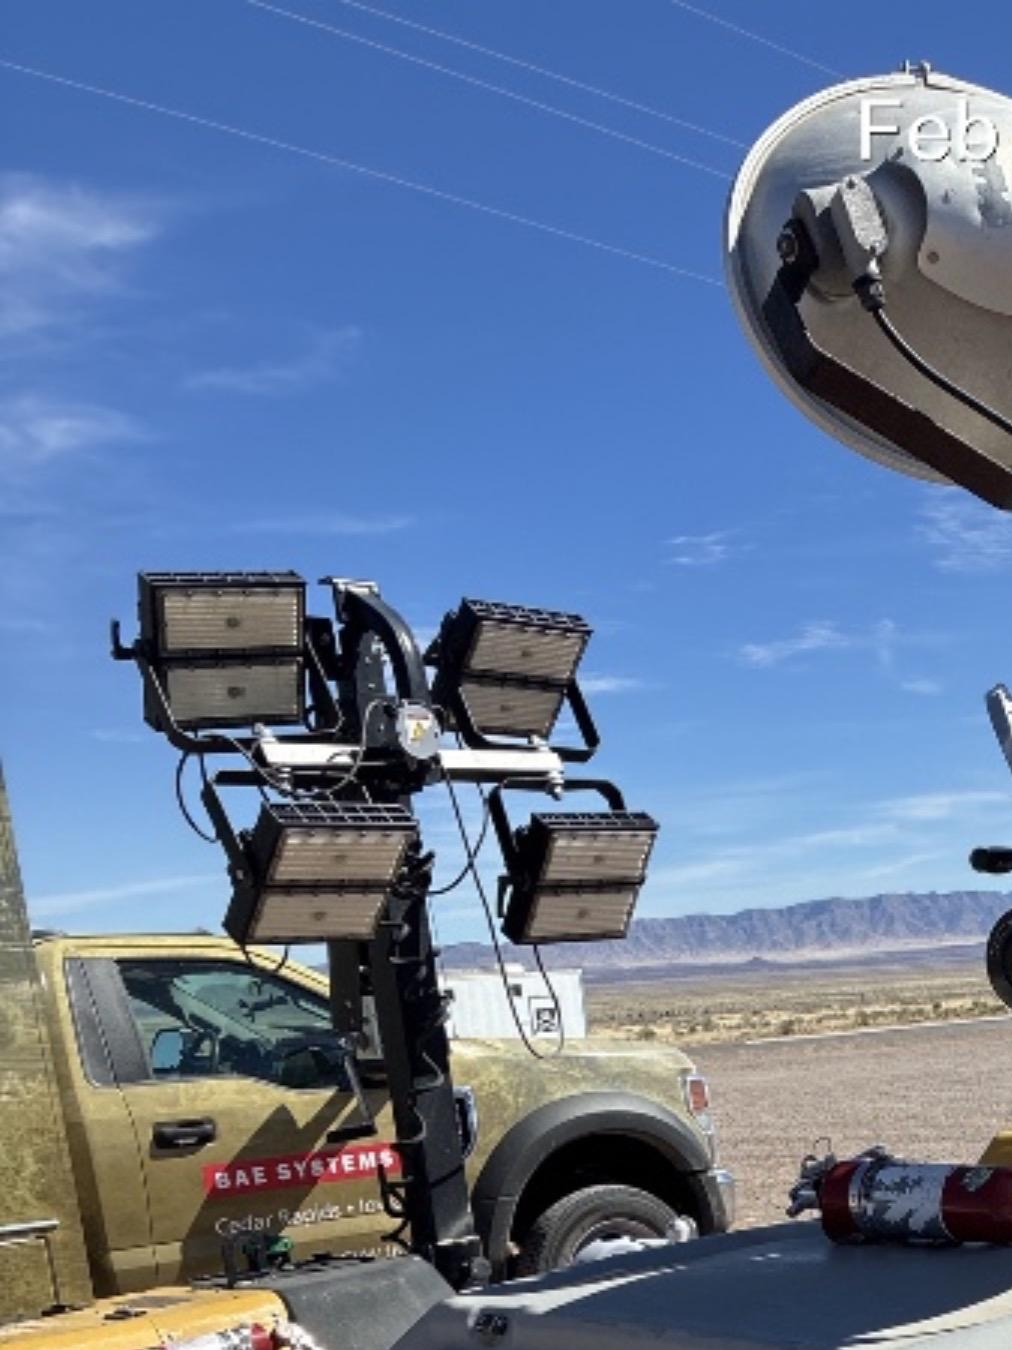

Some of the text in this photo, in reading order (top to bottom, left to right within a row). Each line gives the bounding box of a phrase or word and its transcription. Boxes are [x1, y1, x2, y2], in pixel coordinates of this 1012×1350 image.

[215, 1150, 395, 1189] BAE SYSTEMS
[214, 1212, 274, 1236] Cedar
